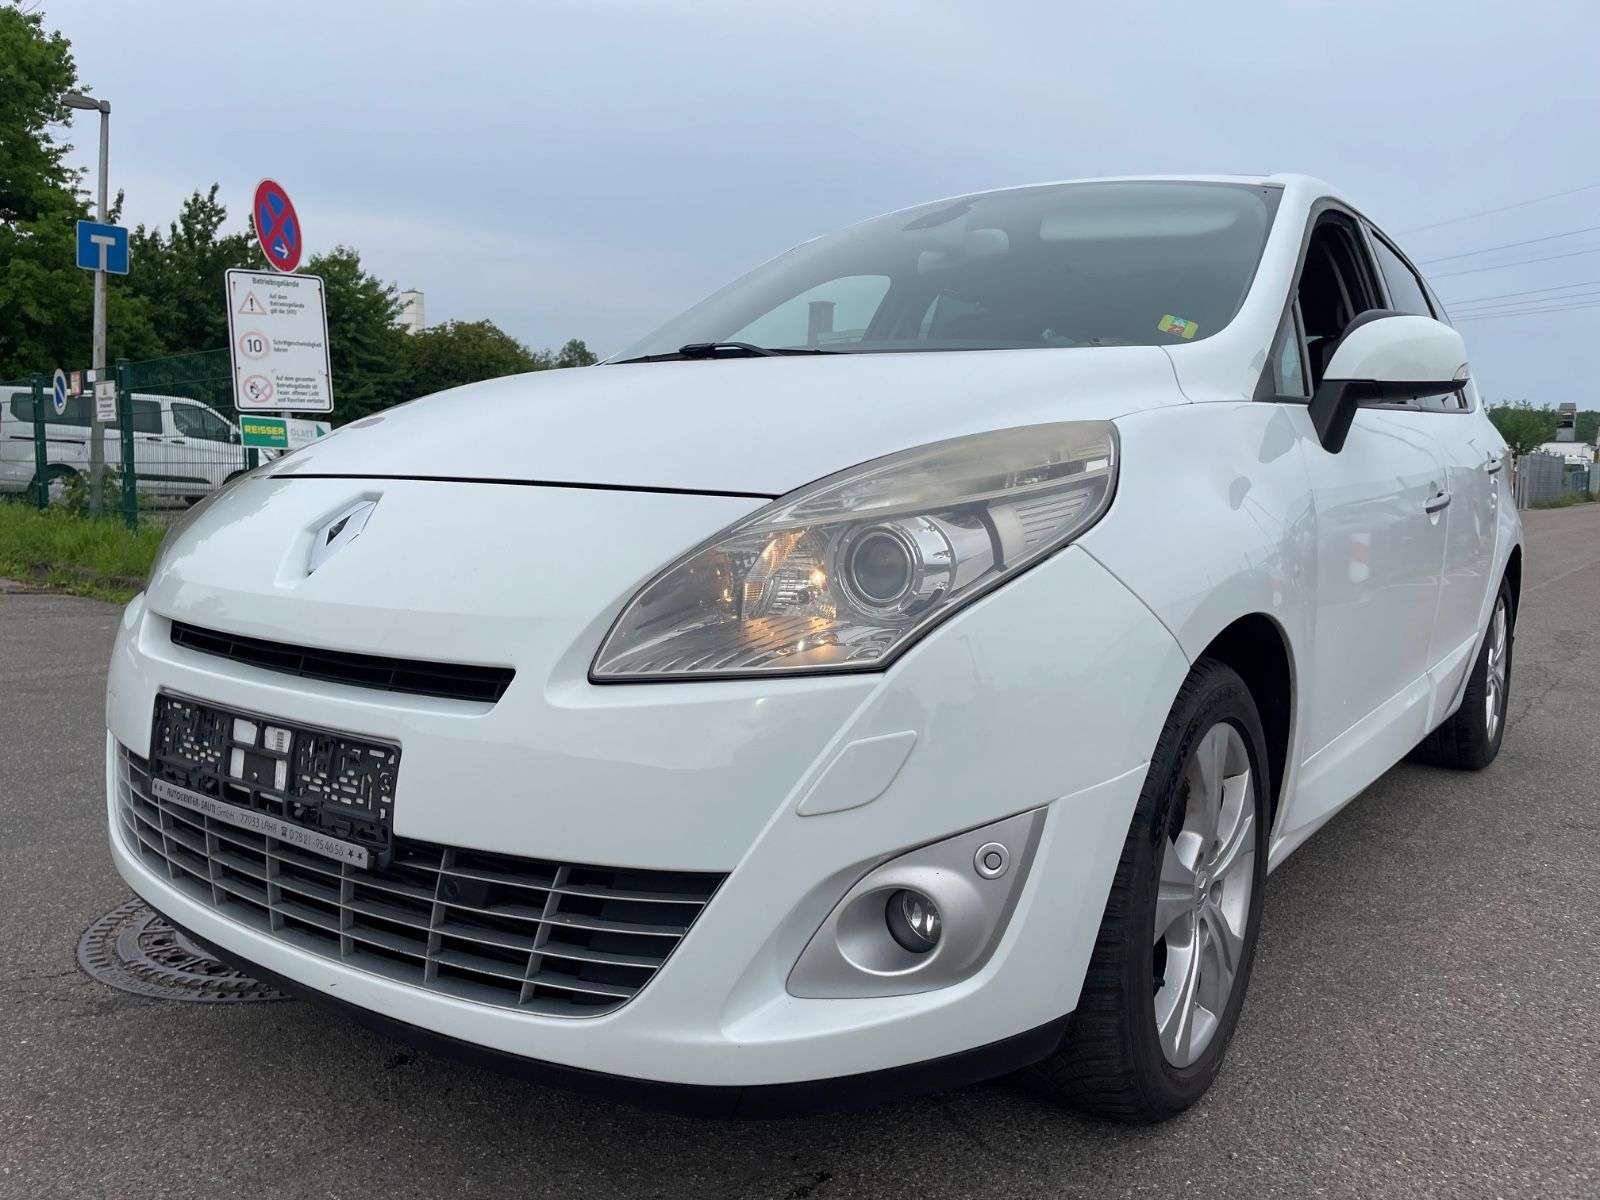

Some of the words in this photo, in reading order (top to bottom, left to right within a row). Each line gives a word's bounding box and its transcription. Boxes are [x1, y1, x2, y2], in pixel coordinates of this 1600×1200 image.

[252, 278, 300, 288] Betriebsgelände
[247, 339, 262, 353] 10
[243, 424, 285, 435] REISSER
